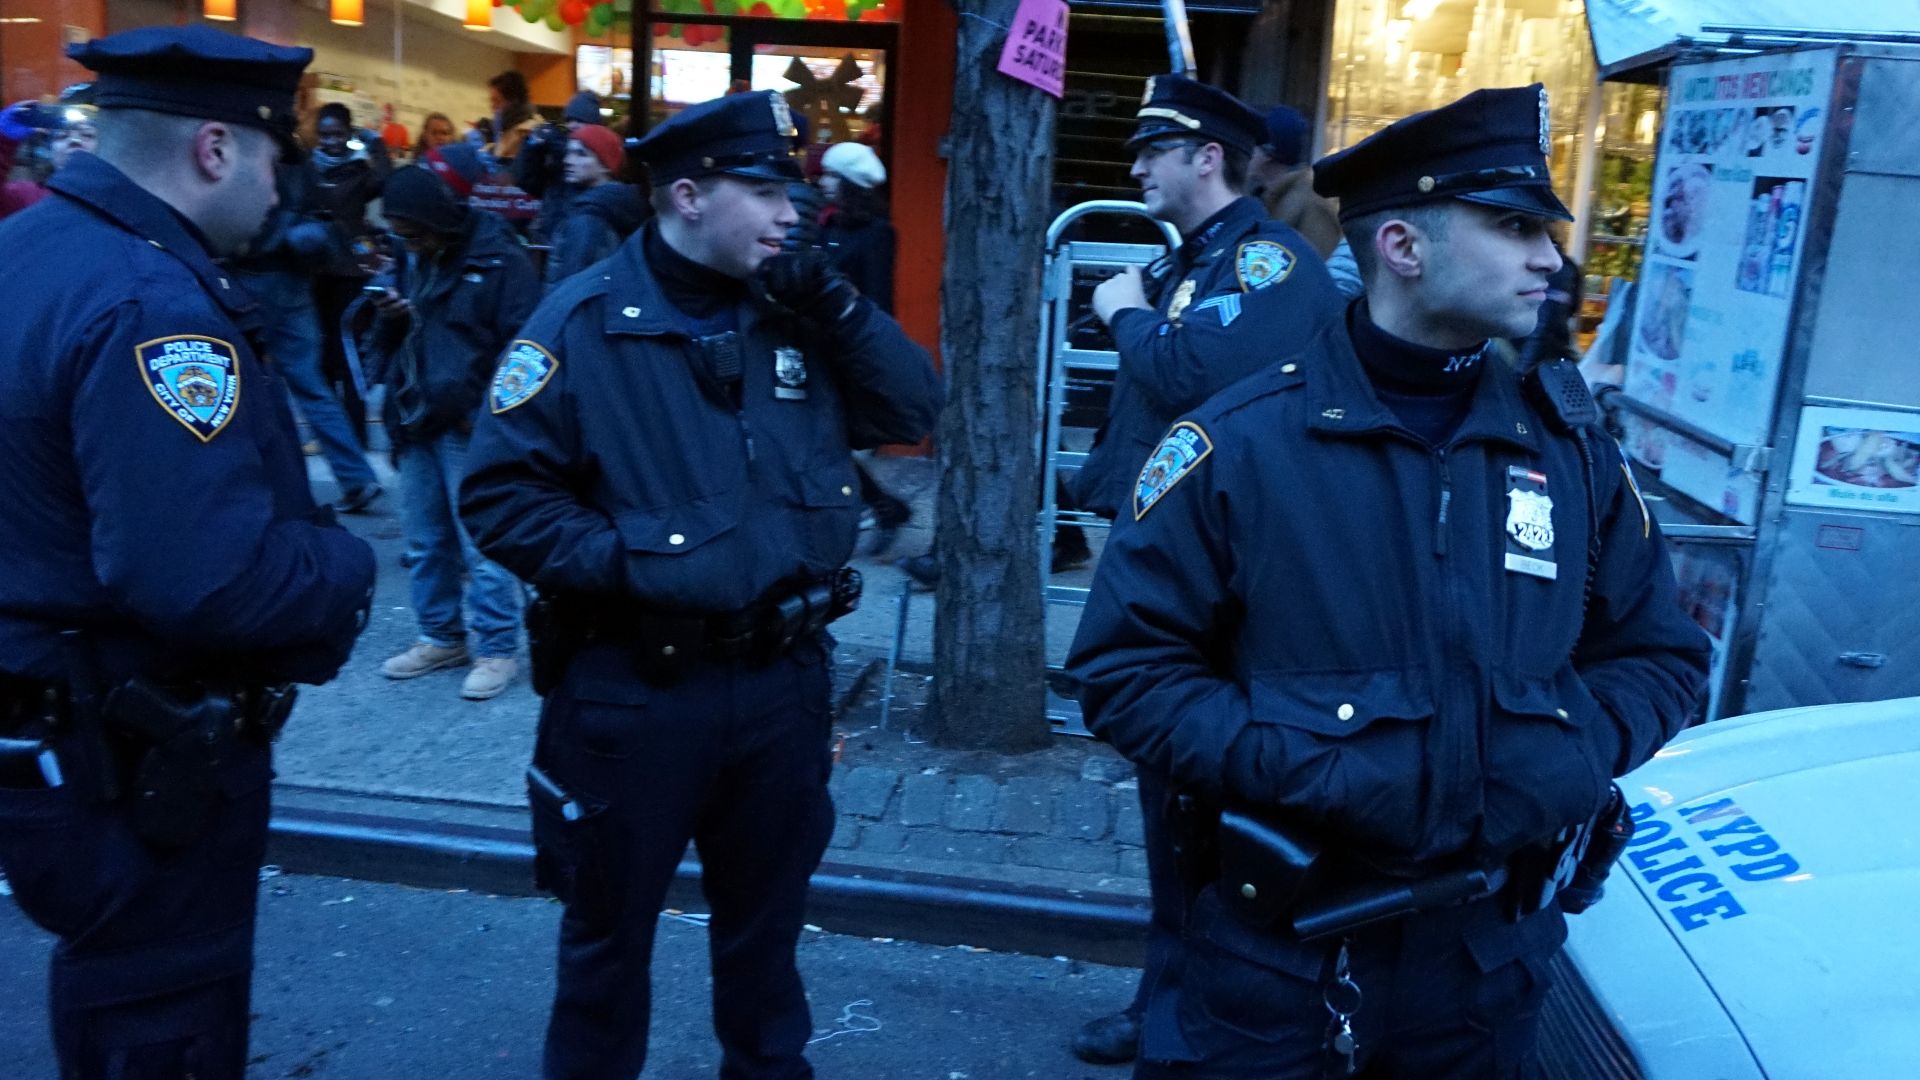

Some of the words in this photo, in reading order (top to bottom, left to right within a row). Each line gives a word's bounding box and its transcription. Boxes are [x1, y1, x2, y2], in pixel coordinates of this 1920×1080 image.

[149, 351, 231, 371] DEPARTMENT
[163, 341, 213, 354] POLICE
[154, 383, 181, 407] CITY
[177, 408, 197, 423] OF
[210, 404, 230, 428] NEW
[223, 374, 237, 404] YORK
[1677, 797, 1801, 882] NYPD
[1626, 802, 1748, 932] POLICE
